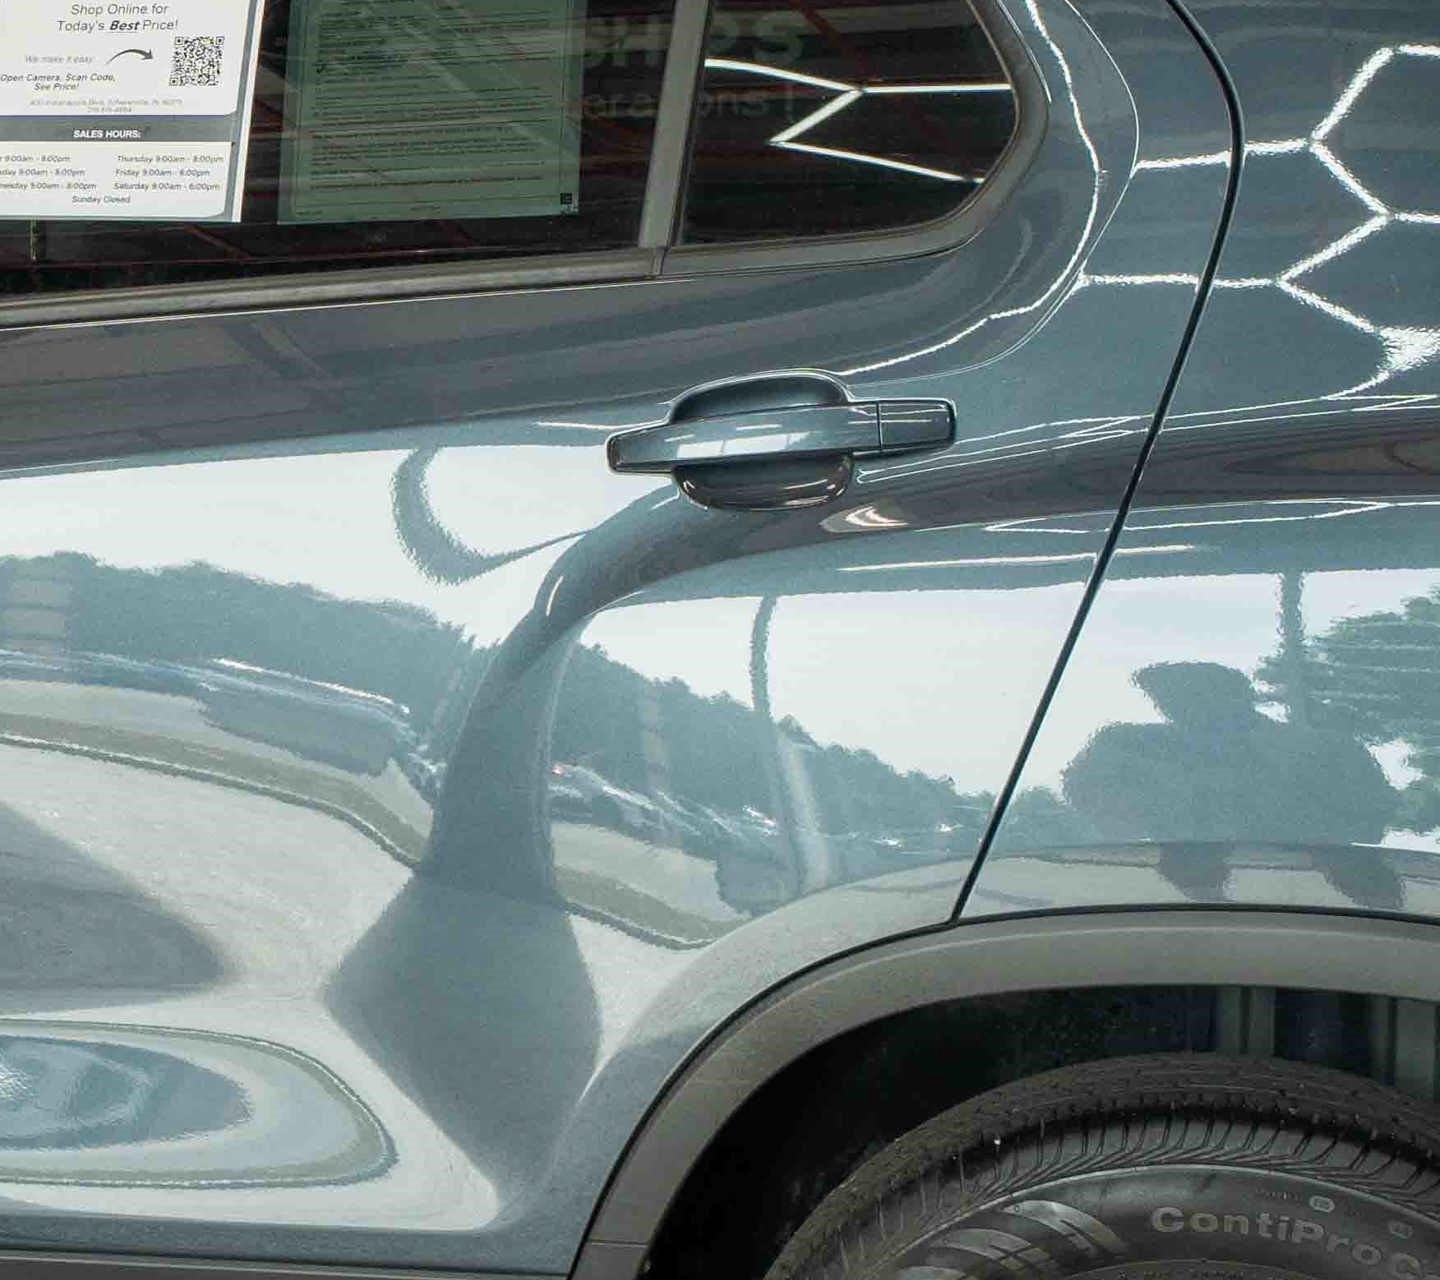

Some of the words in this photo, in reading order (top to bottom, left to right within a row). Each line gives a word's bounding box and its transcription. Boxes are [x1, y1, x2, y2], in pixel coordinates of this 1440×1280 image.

[71, 4, 103, 16] Shop
[107, 4, 148, 15] Online
[151, 4, 169, 14] for
[57, 20, 105, 33] Today's
[109, 20, 141, 32] Best
[142, 20, 178, 31] Price!
[73, 129, 103, 139] SALES
[105, 130, 141, 138] HOURS:
[117, 155, 153, 164] Thursday
[115, 169, 139, 178] Friday
[113, 182, 149, 191] Saturday
[72, 196, 101, 205] Sunday
[103, 196, 130, 204] Closed
